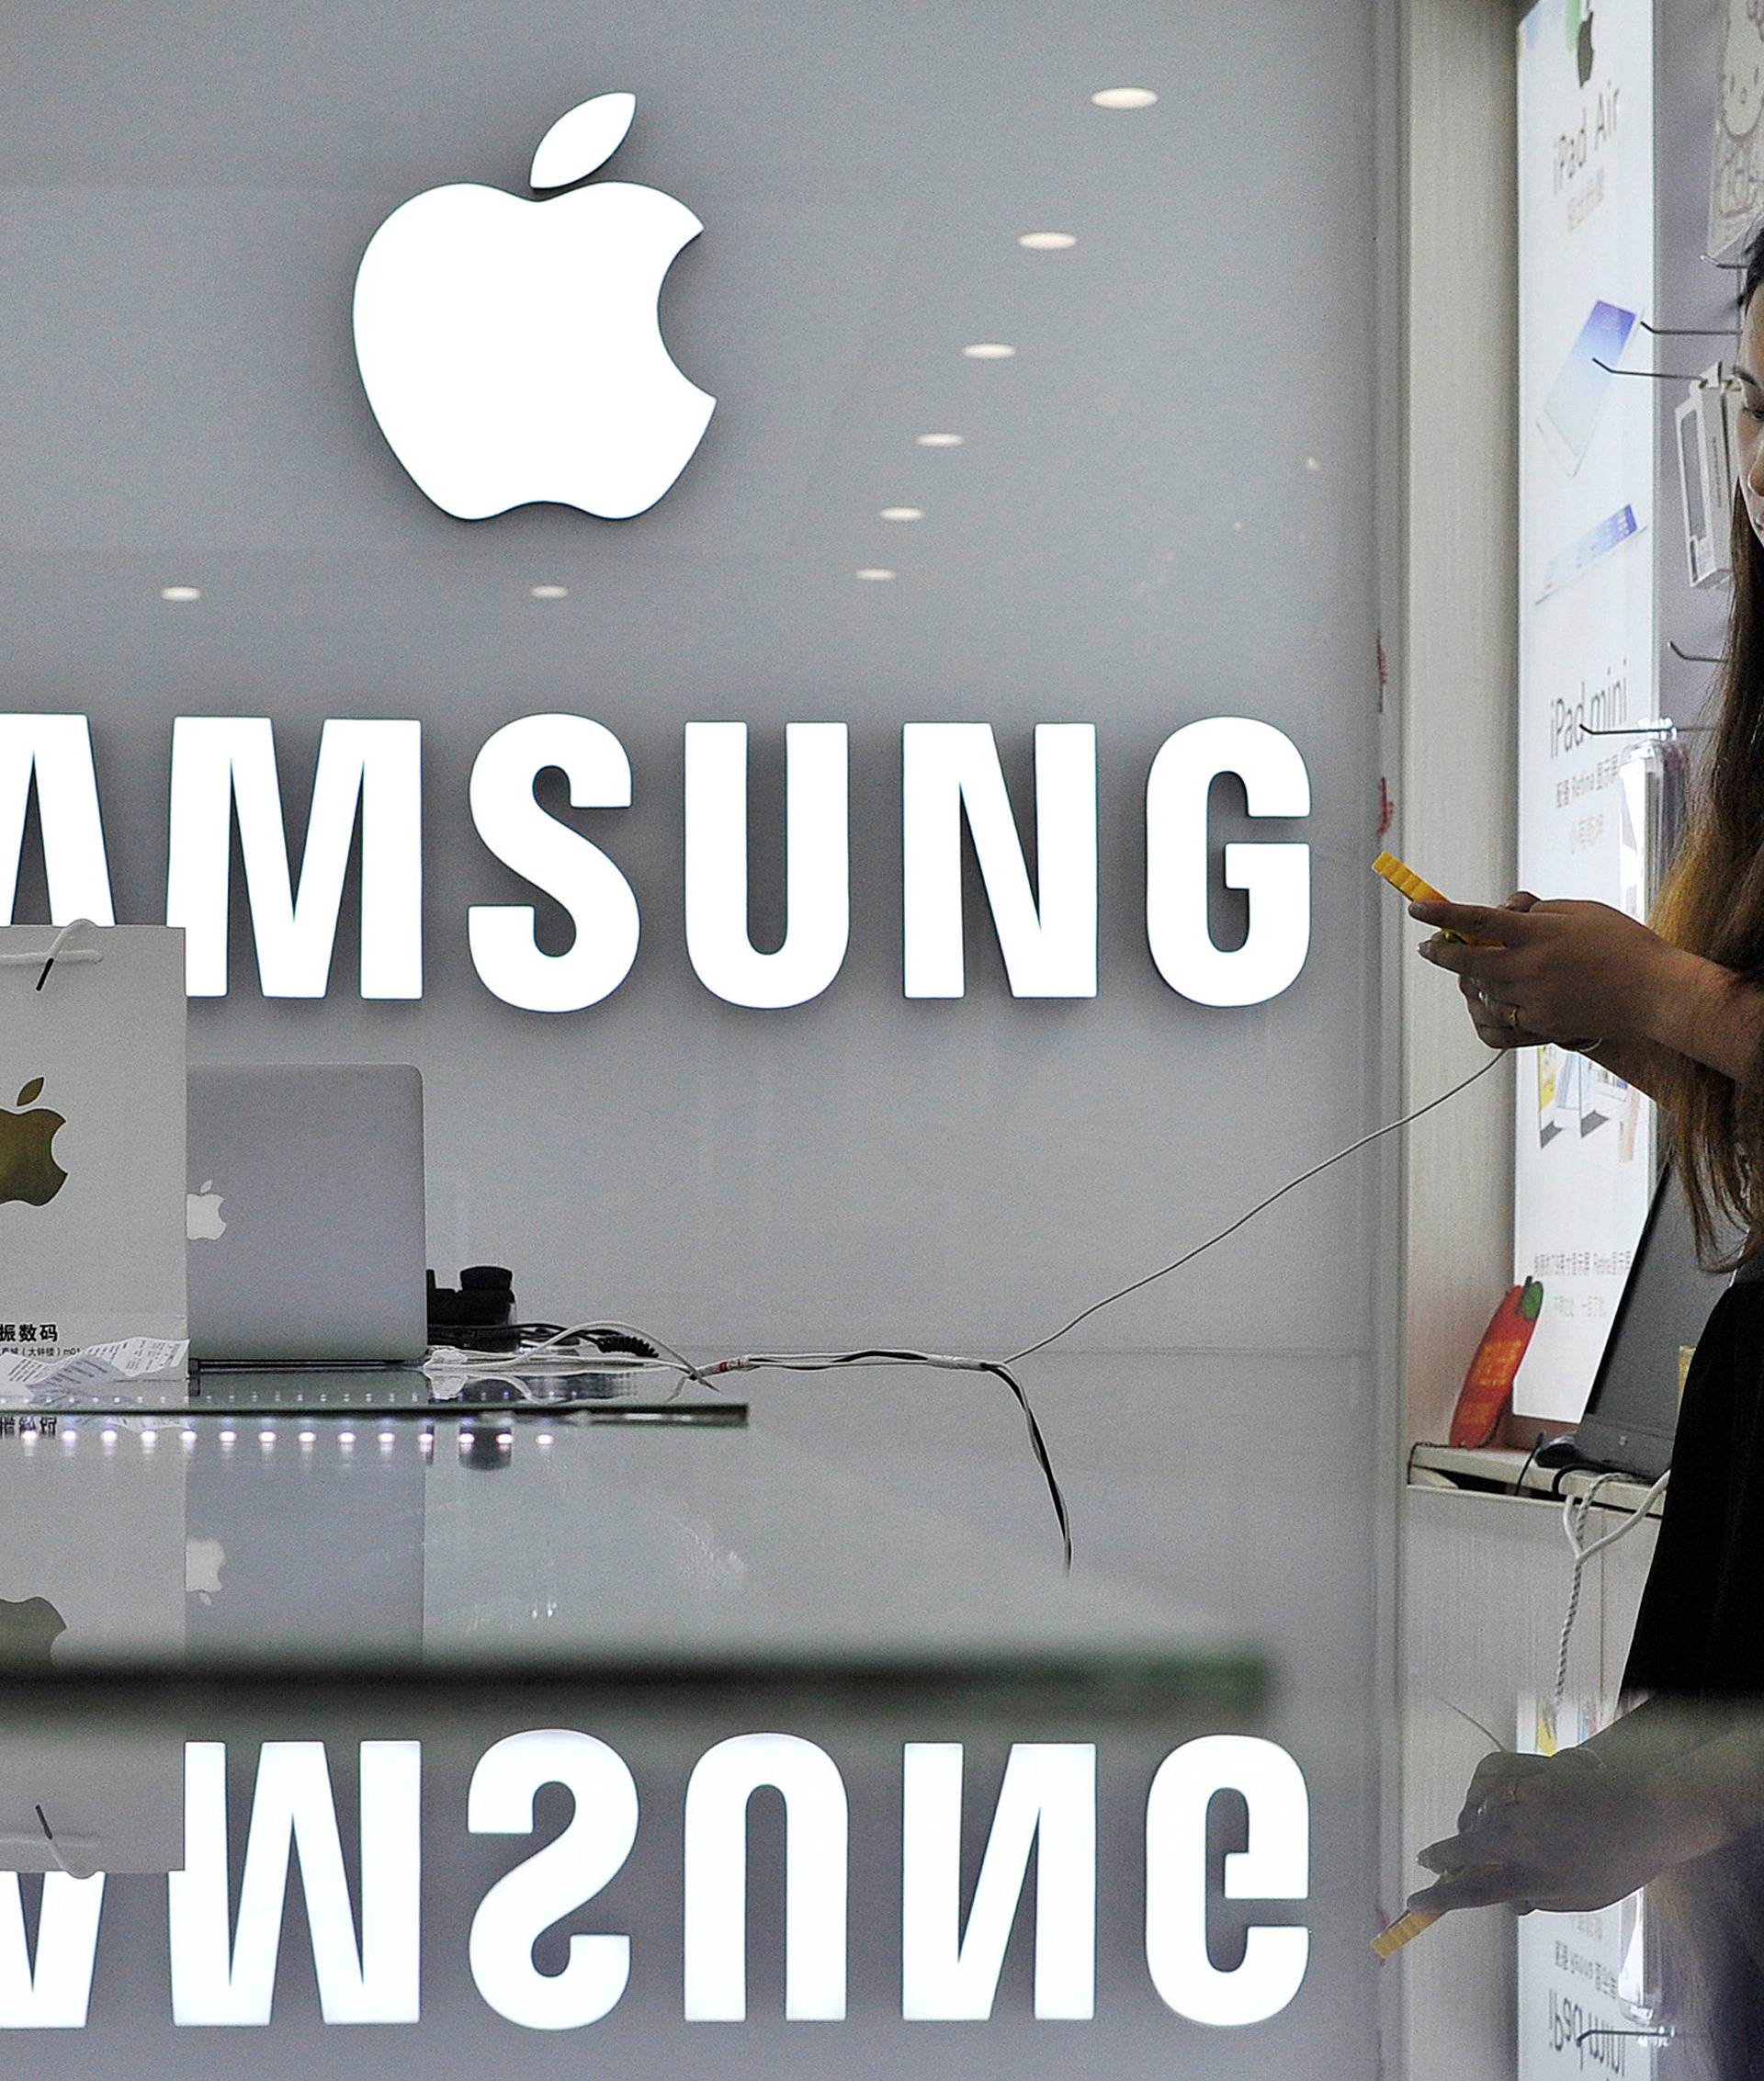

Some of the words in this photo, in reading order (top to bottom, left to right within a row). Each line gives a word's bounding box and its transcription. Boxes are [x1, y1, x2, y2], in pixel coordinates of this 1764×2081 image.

[1553, 107, 1587, 196] iPad
[1594, 79, 1620, 151] Air
[1550, 680, 1586, 759] iPad
[1589, 657, 1628, 739] mini
[0, 1324, 58, 1342] 振数码
